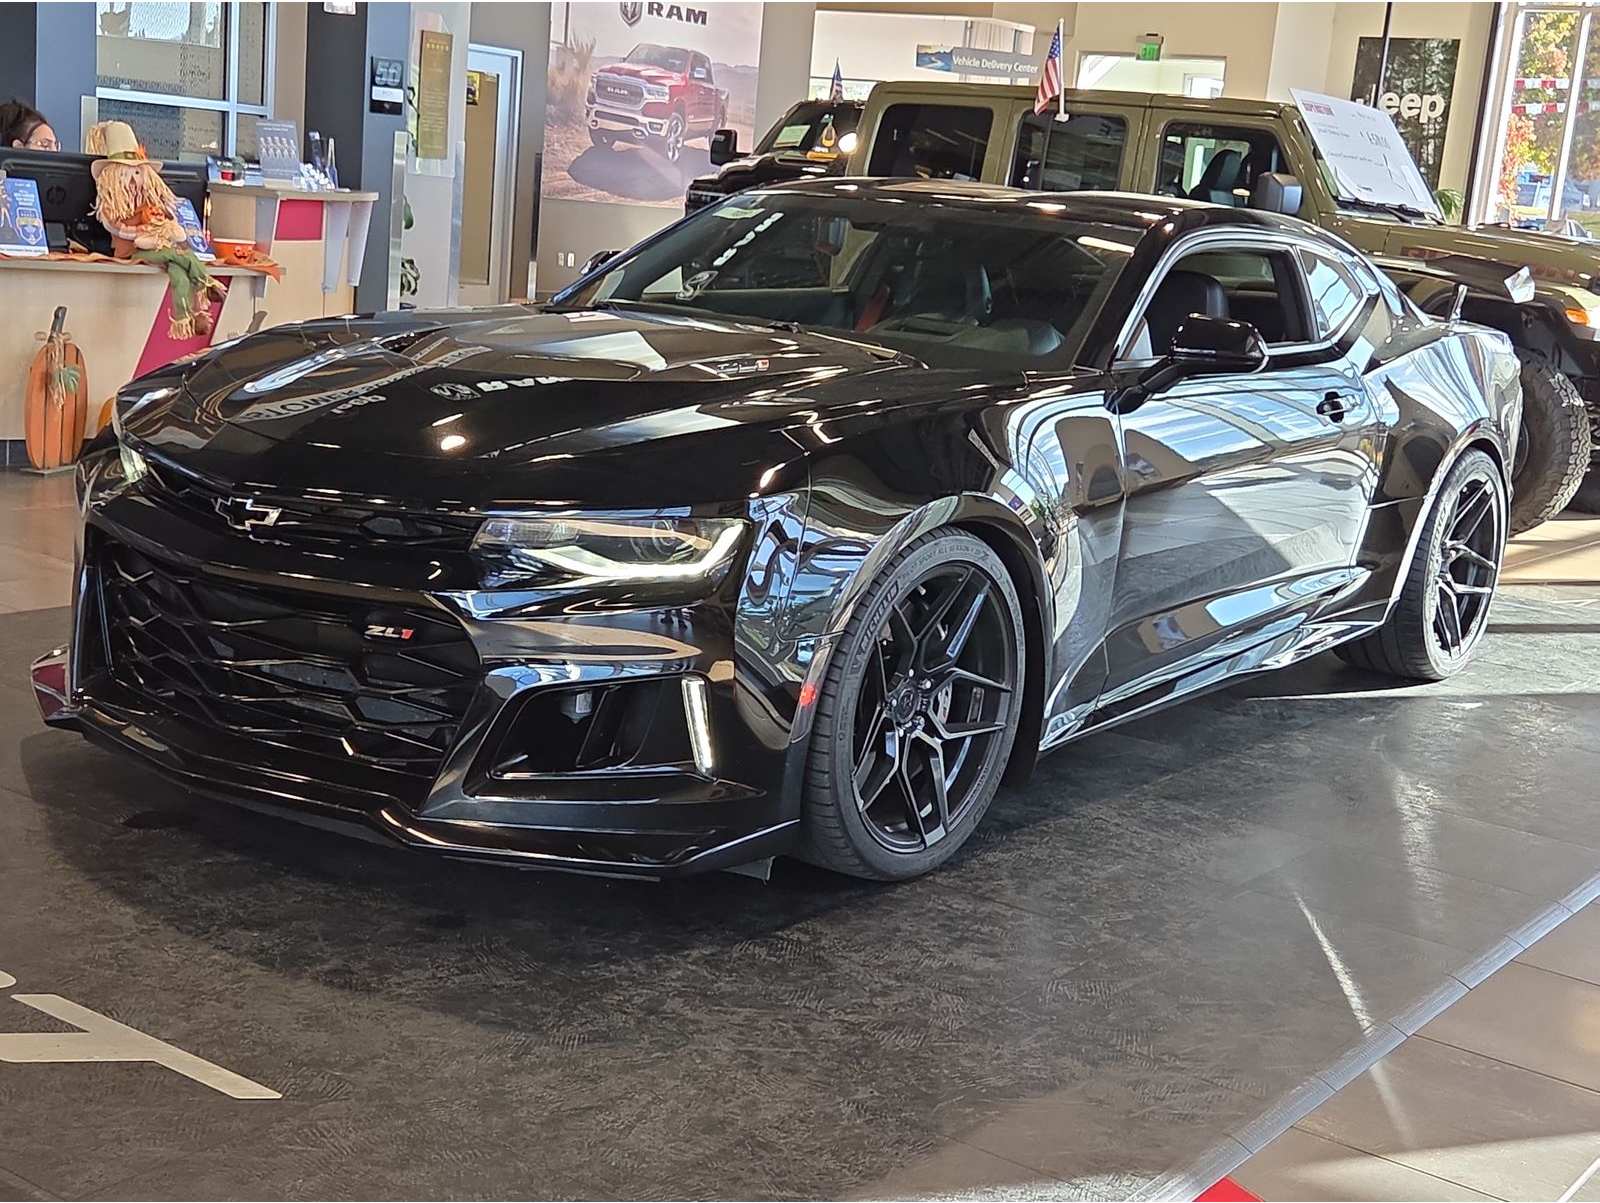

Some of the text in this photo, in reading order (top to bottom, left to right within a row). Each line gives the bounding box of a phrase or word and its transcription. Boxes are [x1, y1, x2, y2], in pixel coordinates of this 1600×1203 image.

[647, 1, 707, 25] RAM
[952, 55, 1038, 73] Vehicle Delivery Center
[364, 625, 414, 639] ZL1
